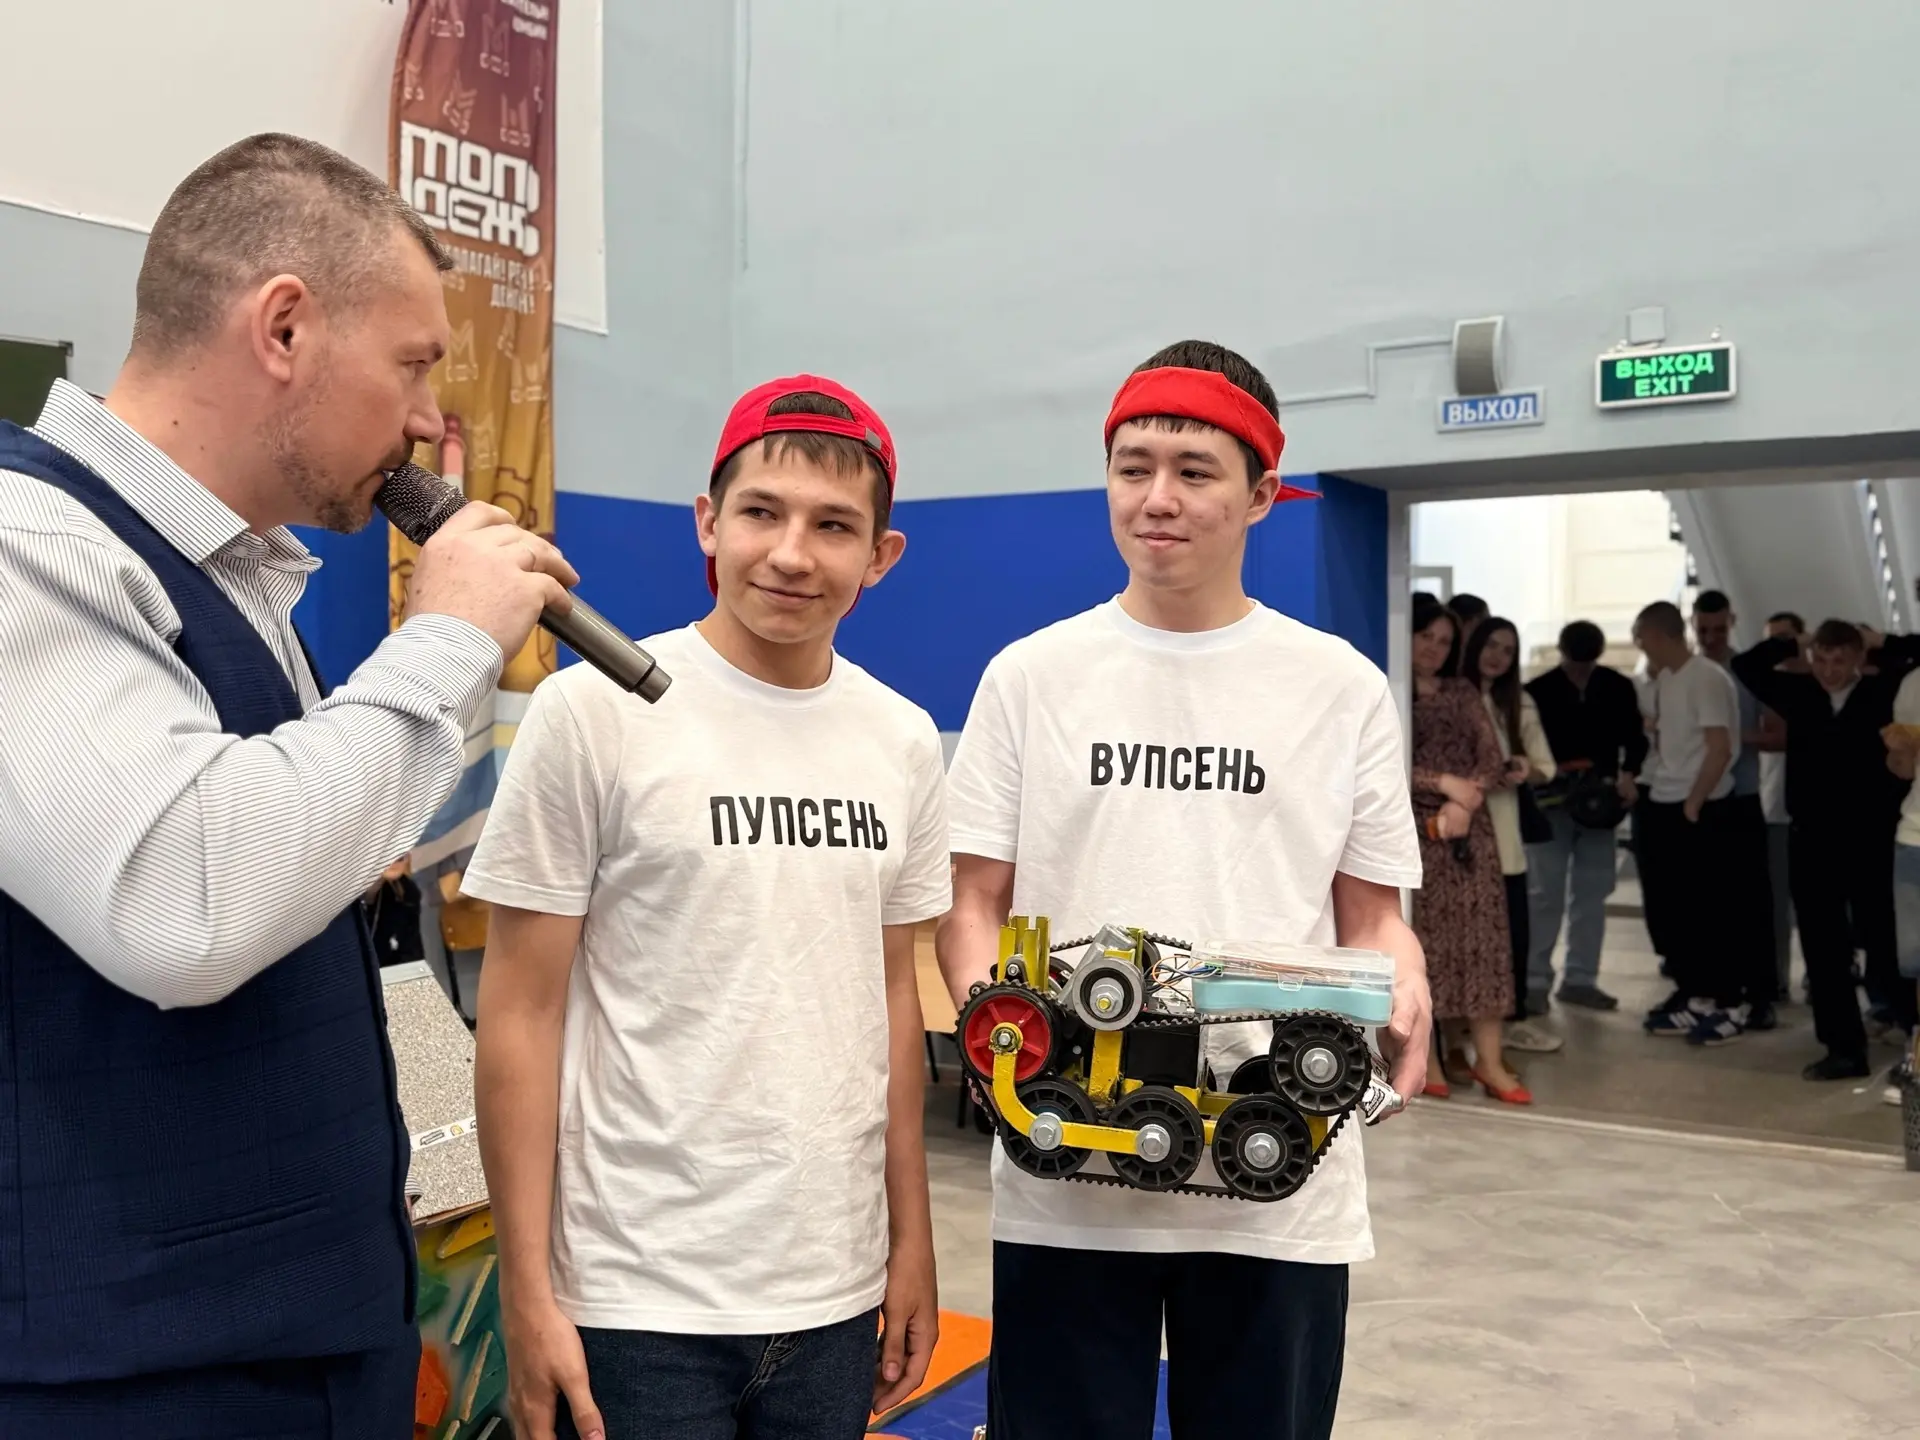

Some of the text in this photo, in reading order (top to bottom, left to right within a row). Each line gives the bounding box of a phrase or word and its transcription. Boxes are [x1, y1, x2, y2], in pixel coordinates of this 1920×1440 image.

[1615, 352, 1714, 378] ВЫХОД
[1634, 374, 1695, 398] EXIT
[1449, 396, 1535, 422] ВЫХОД
[1091, 743, 1265, 794] ВУПСЕНЬ
[711, 797, 887, 850] ПУПСЕНЬ
